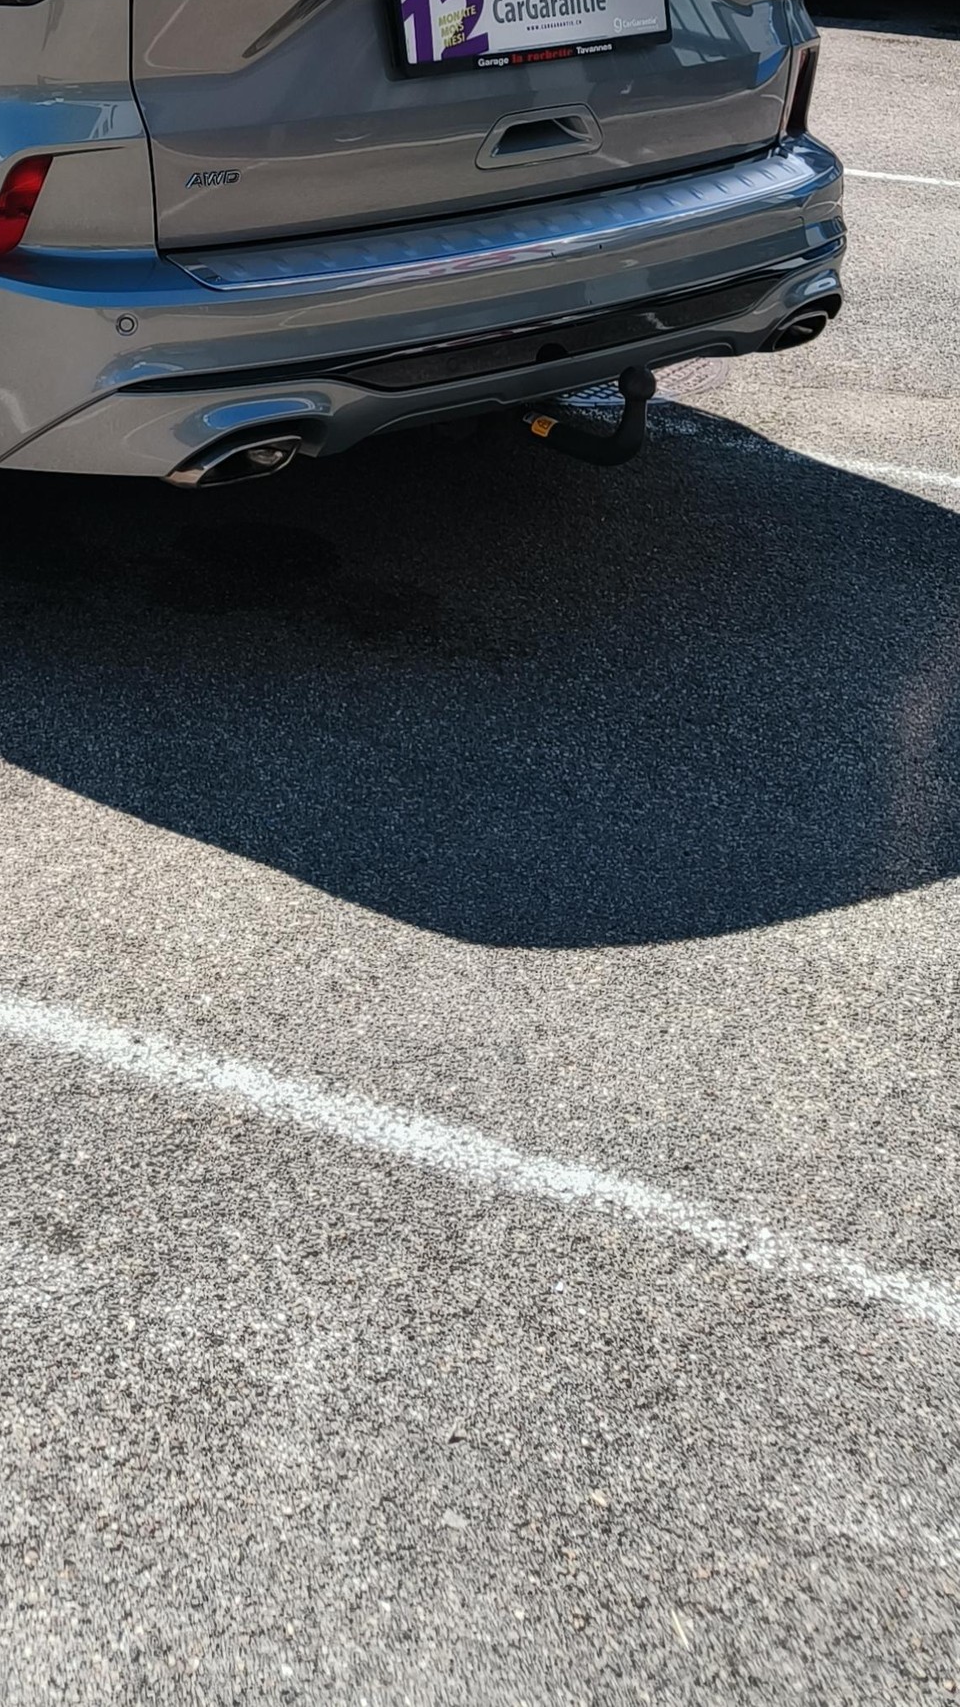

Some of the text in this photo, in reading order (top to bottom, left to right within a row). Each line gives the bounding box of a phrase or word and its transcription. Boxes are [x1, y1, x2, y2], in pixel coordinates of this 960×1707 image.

[438, 4, 476, 27] MONATE
[440, 21, 465, 38] MOIS
[443, 32, 466, 48] MESI
[478, 56, 509, 67] Garage
[576, 43, 613, 55] Tavannes
[185, 169, 241, 189] AWD
